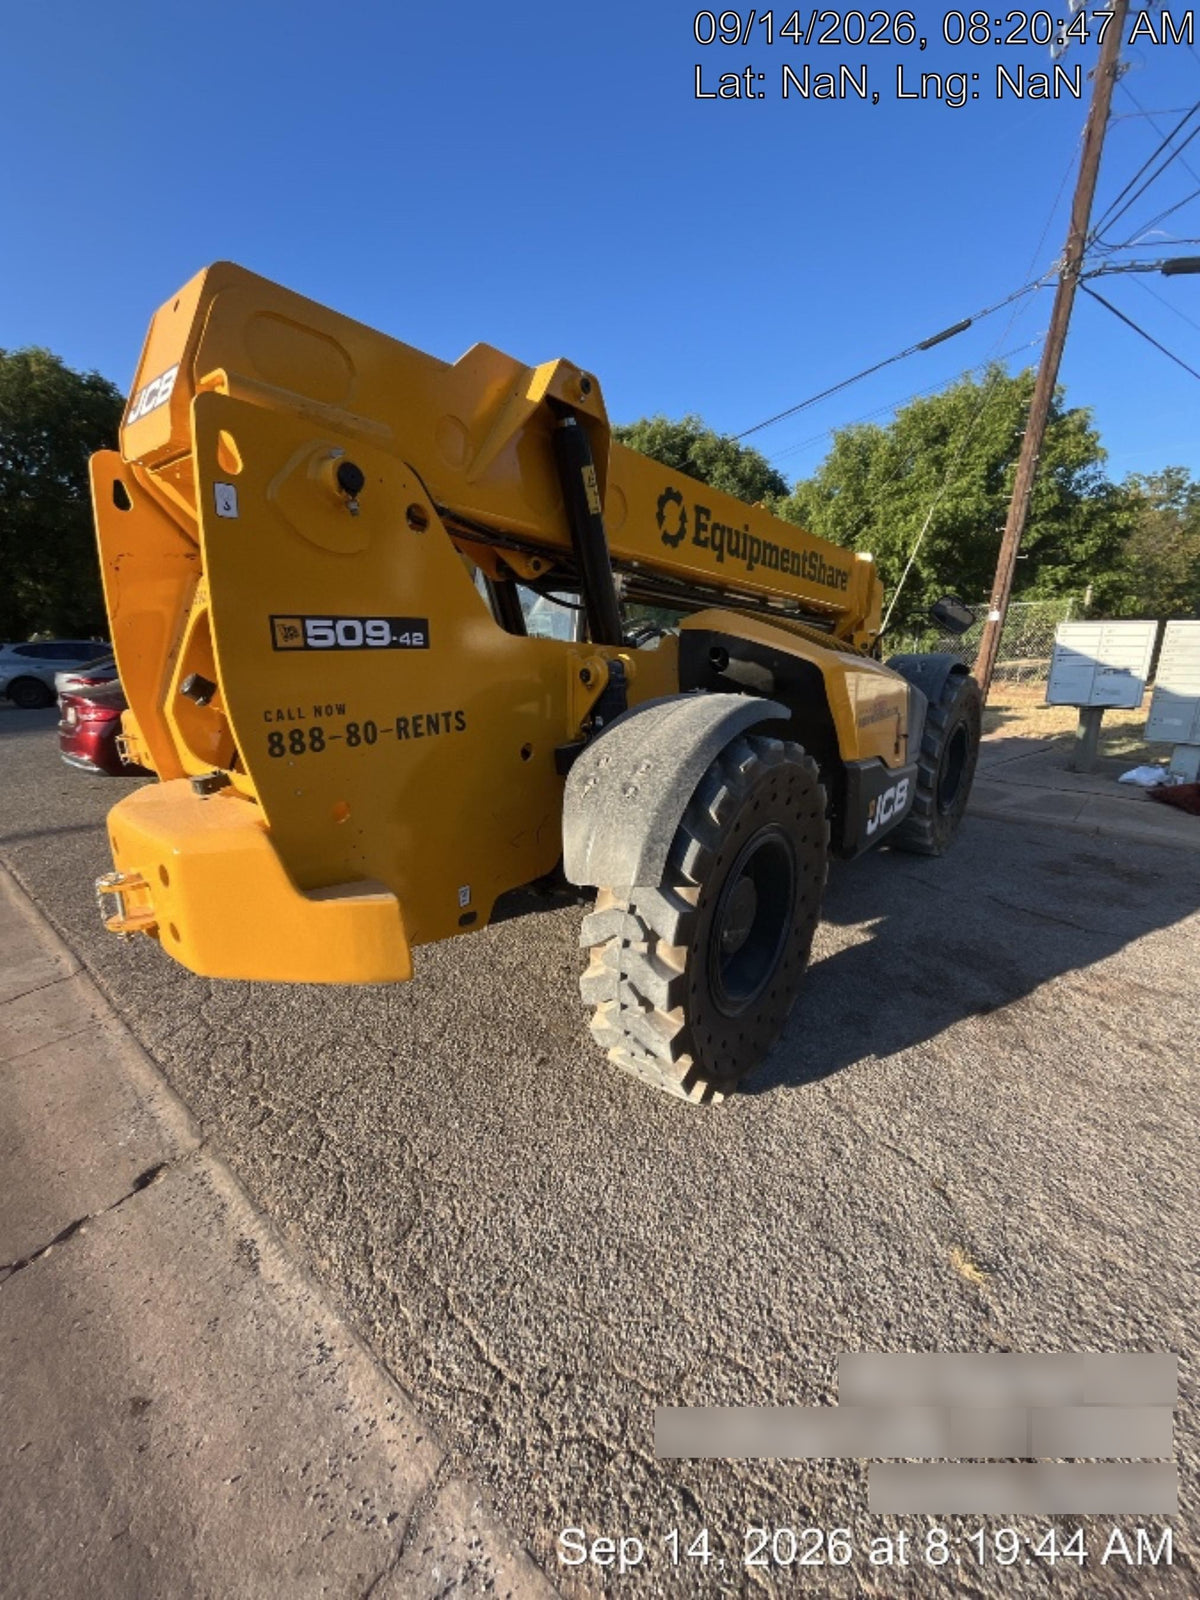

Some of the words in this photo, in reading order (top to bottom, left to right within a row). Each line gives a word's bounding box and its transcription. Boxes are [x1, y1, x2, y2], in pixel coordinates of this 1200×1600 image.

[127, 365, 180, 424] JCB
[692, 504, 849, 591] EquipmentShare
[264, 707, 306, 723] CALL
[313, 703, 347, 717] NOW
[267, 710, 467, 758] 888-80-RENTS
[866, 778, 909, 835] JCB
